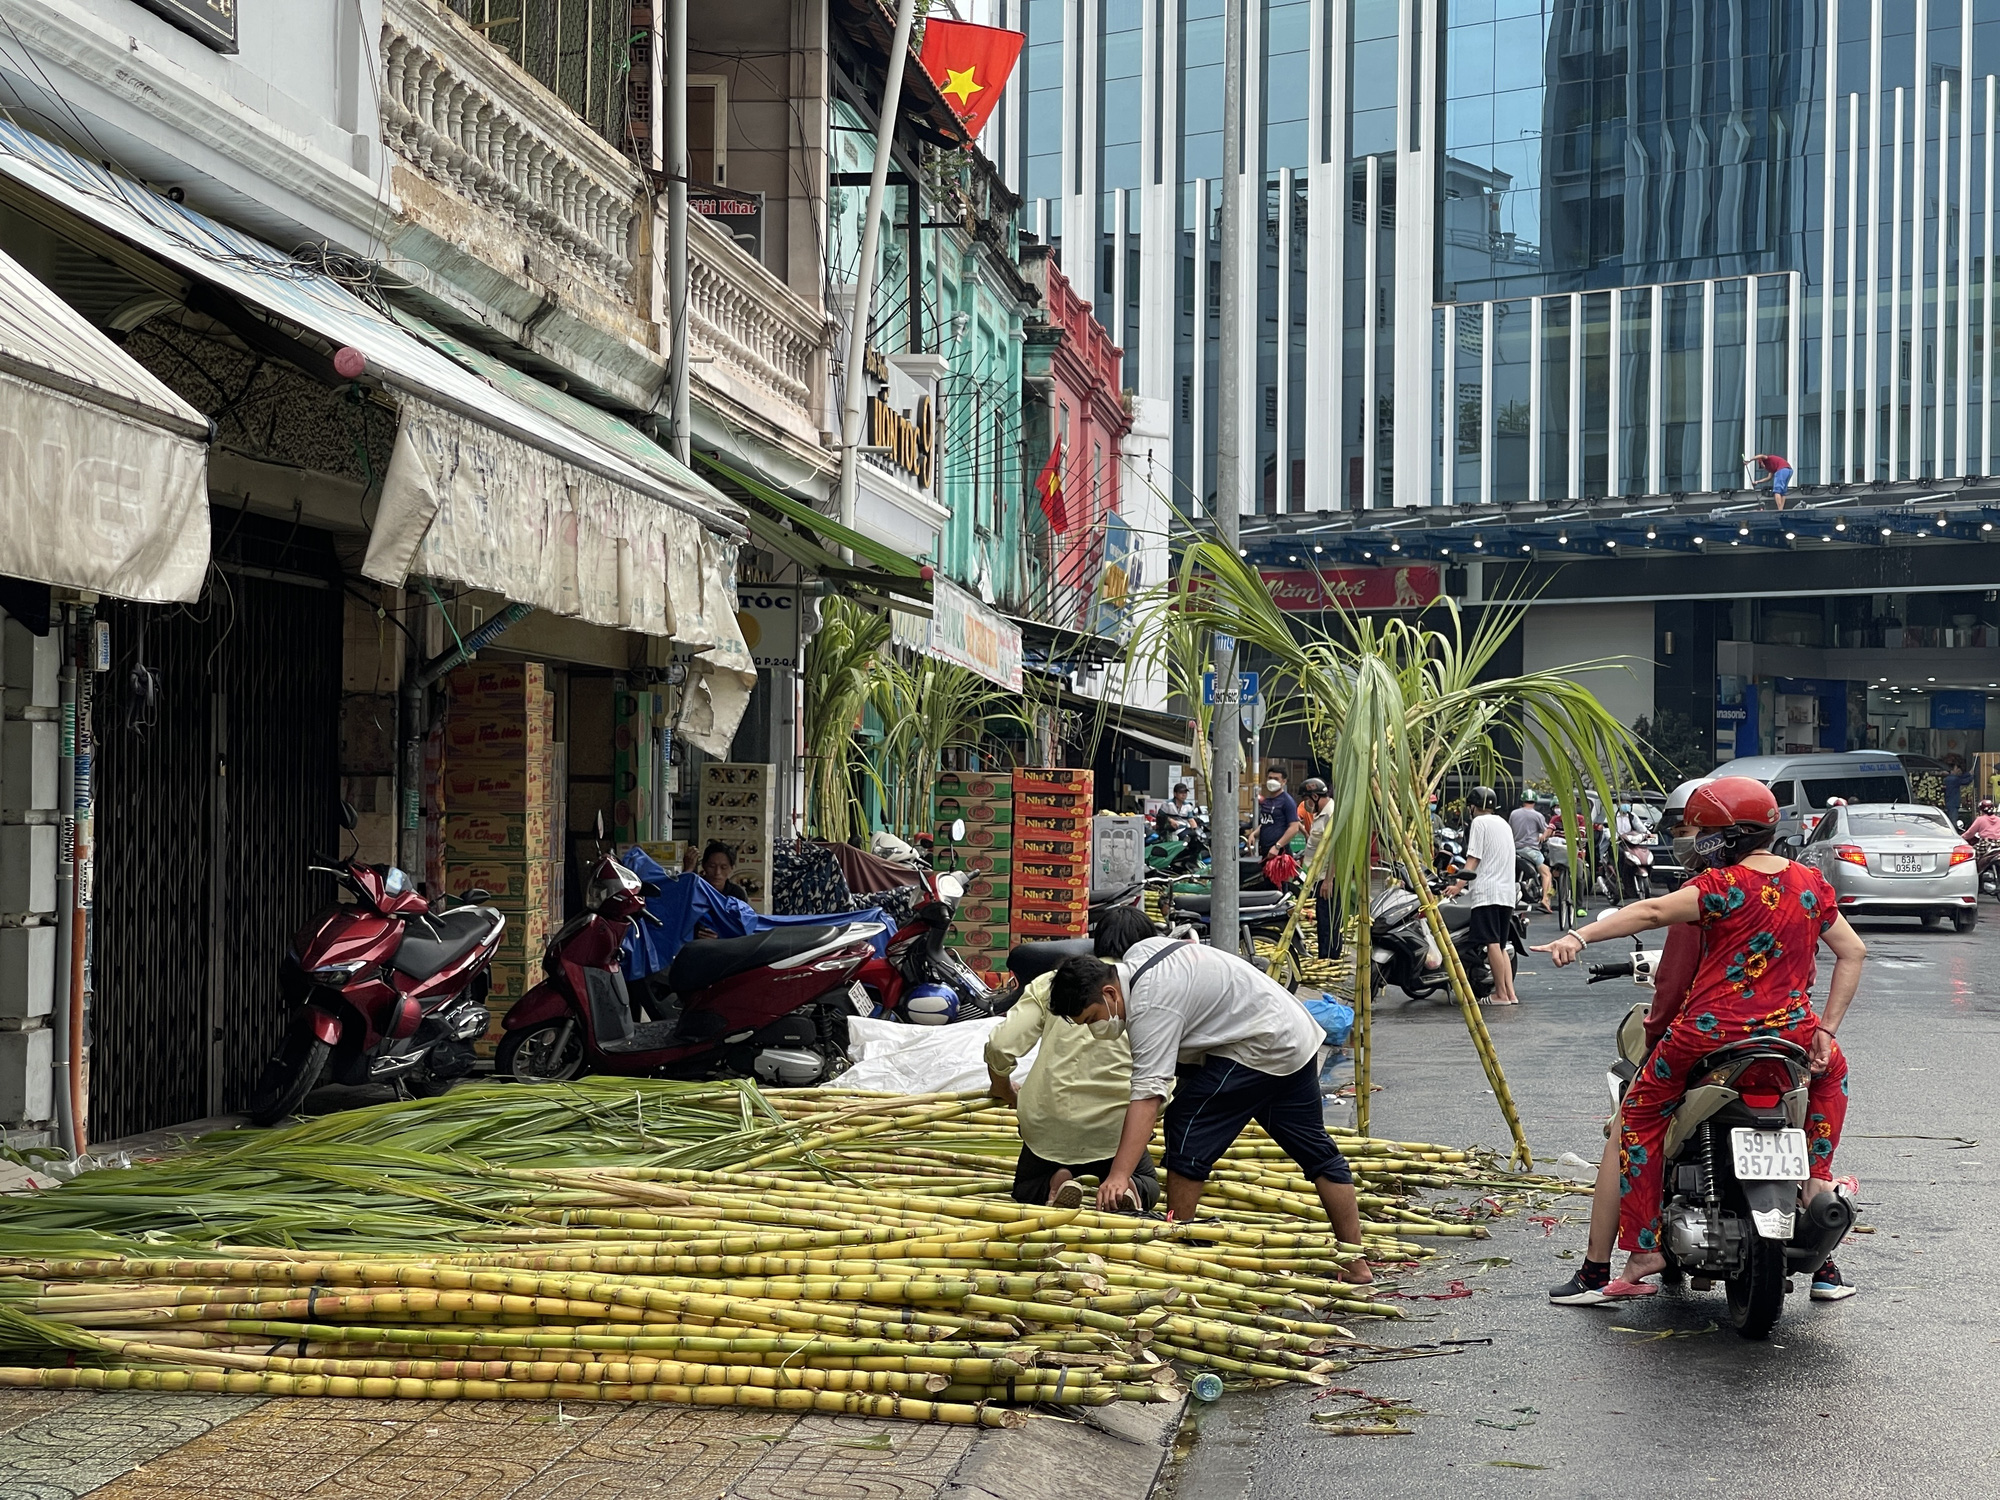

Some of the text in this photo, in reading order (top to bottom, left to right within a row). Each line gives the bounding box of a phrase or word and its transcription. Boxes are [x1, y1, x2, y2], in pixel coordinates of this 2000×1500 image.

[918, 394, 934, 489] 9
[739, 592, 792, 609] TÓC
[1716, 708, 1746, 719] nasonic
[475, 829, 506, 844] Chay
[1901, 855, 1916, 864] 63A
[1896, 864, 1922, 873] 035.69
[475, 879, 507, 893] Chay
[1743, 1132, 1793, 1154] 59-K1
[1738, 1155, 1804, 1177] 357.43
